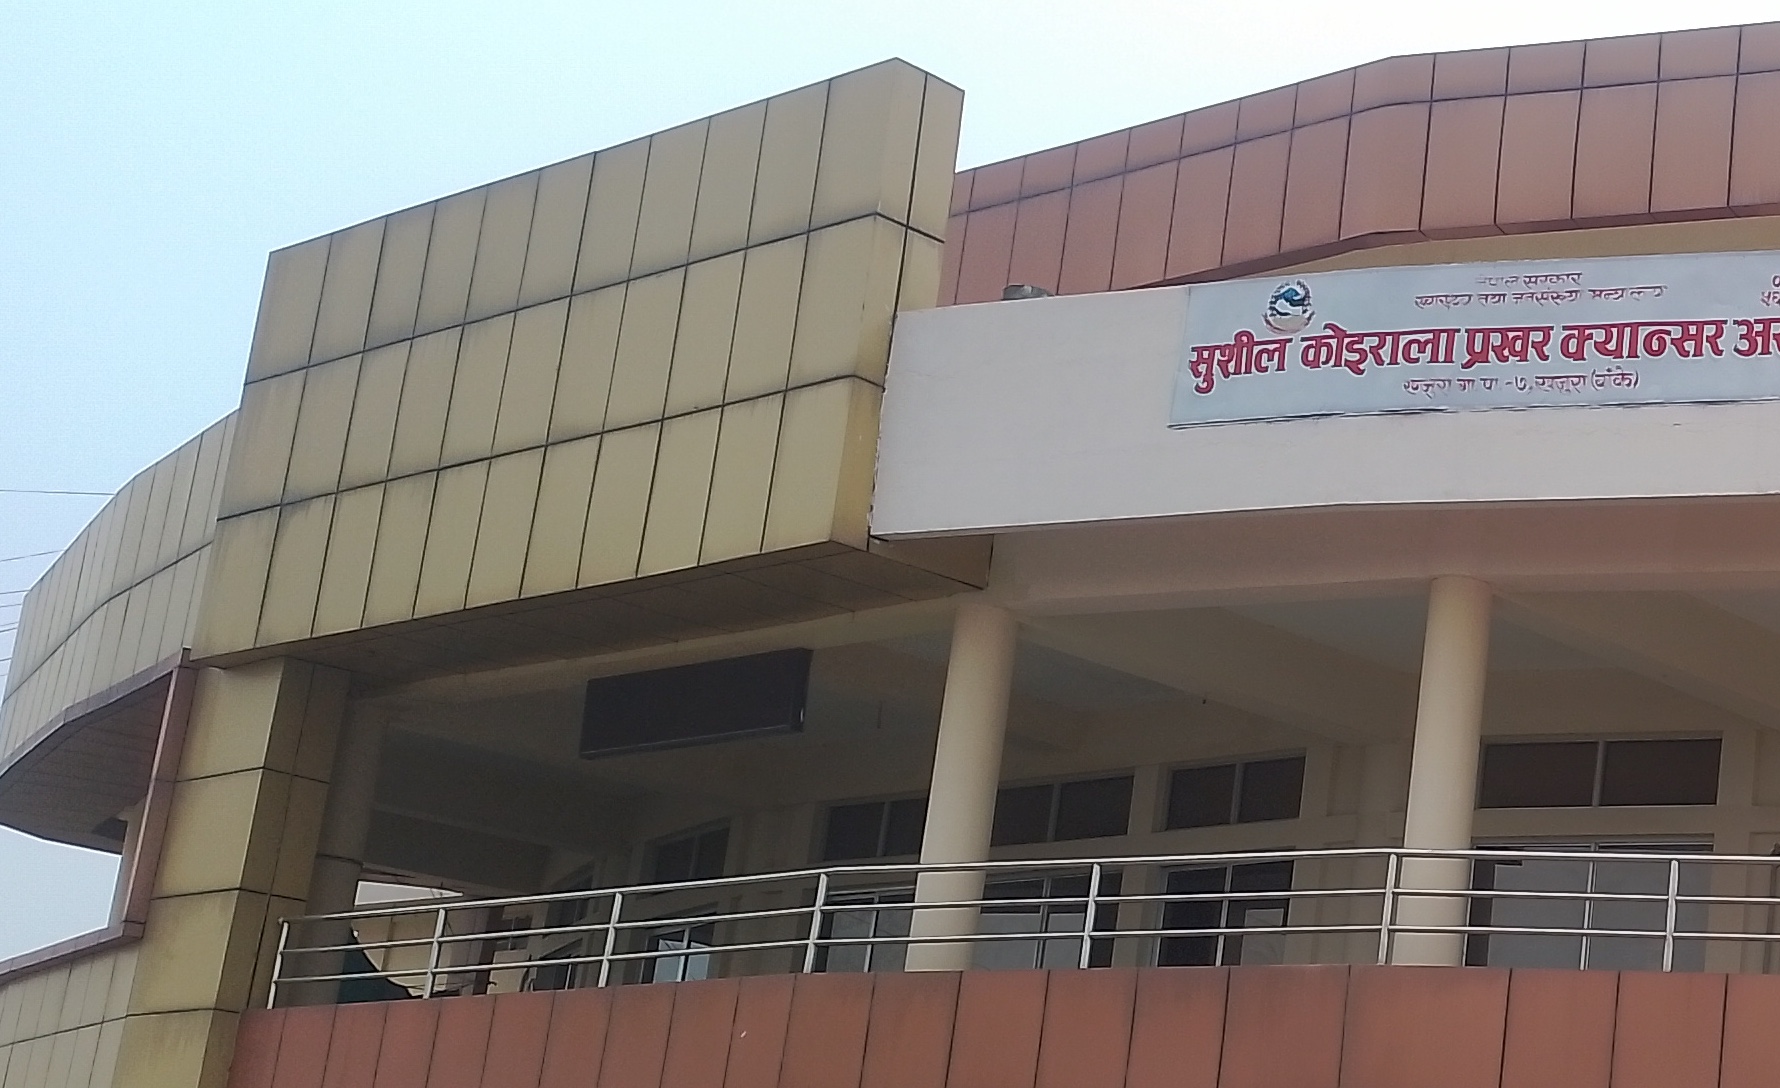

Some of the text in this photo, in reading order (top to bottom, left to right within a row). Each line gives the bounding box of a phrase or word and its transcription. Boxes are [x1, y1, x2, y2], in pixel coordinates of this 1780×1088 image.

[1477, 291, 1508, 307] तथा
[1188, 330, 1294, 395] सुशील
[1300, 322, 1461, 377] कोइराला
[1460, 325, 1555, 370] प्रखर
[1561, 319, 1728, 361] क्यान्सर
